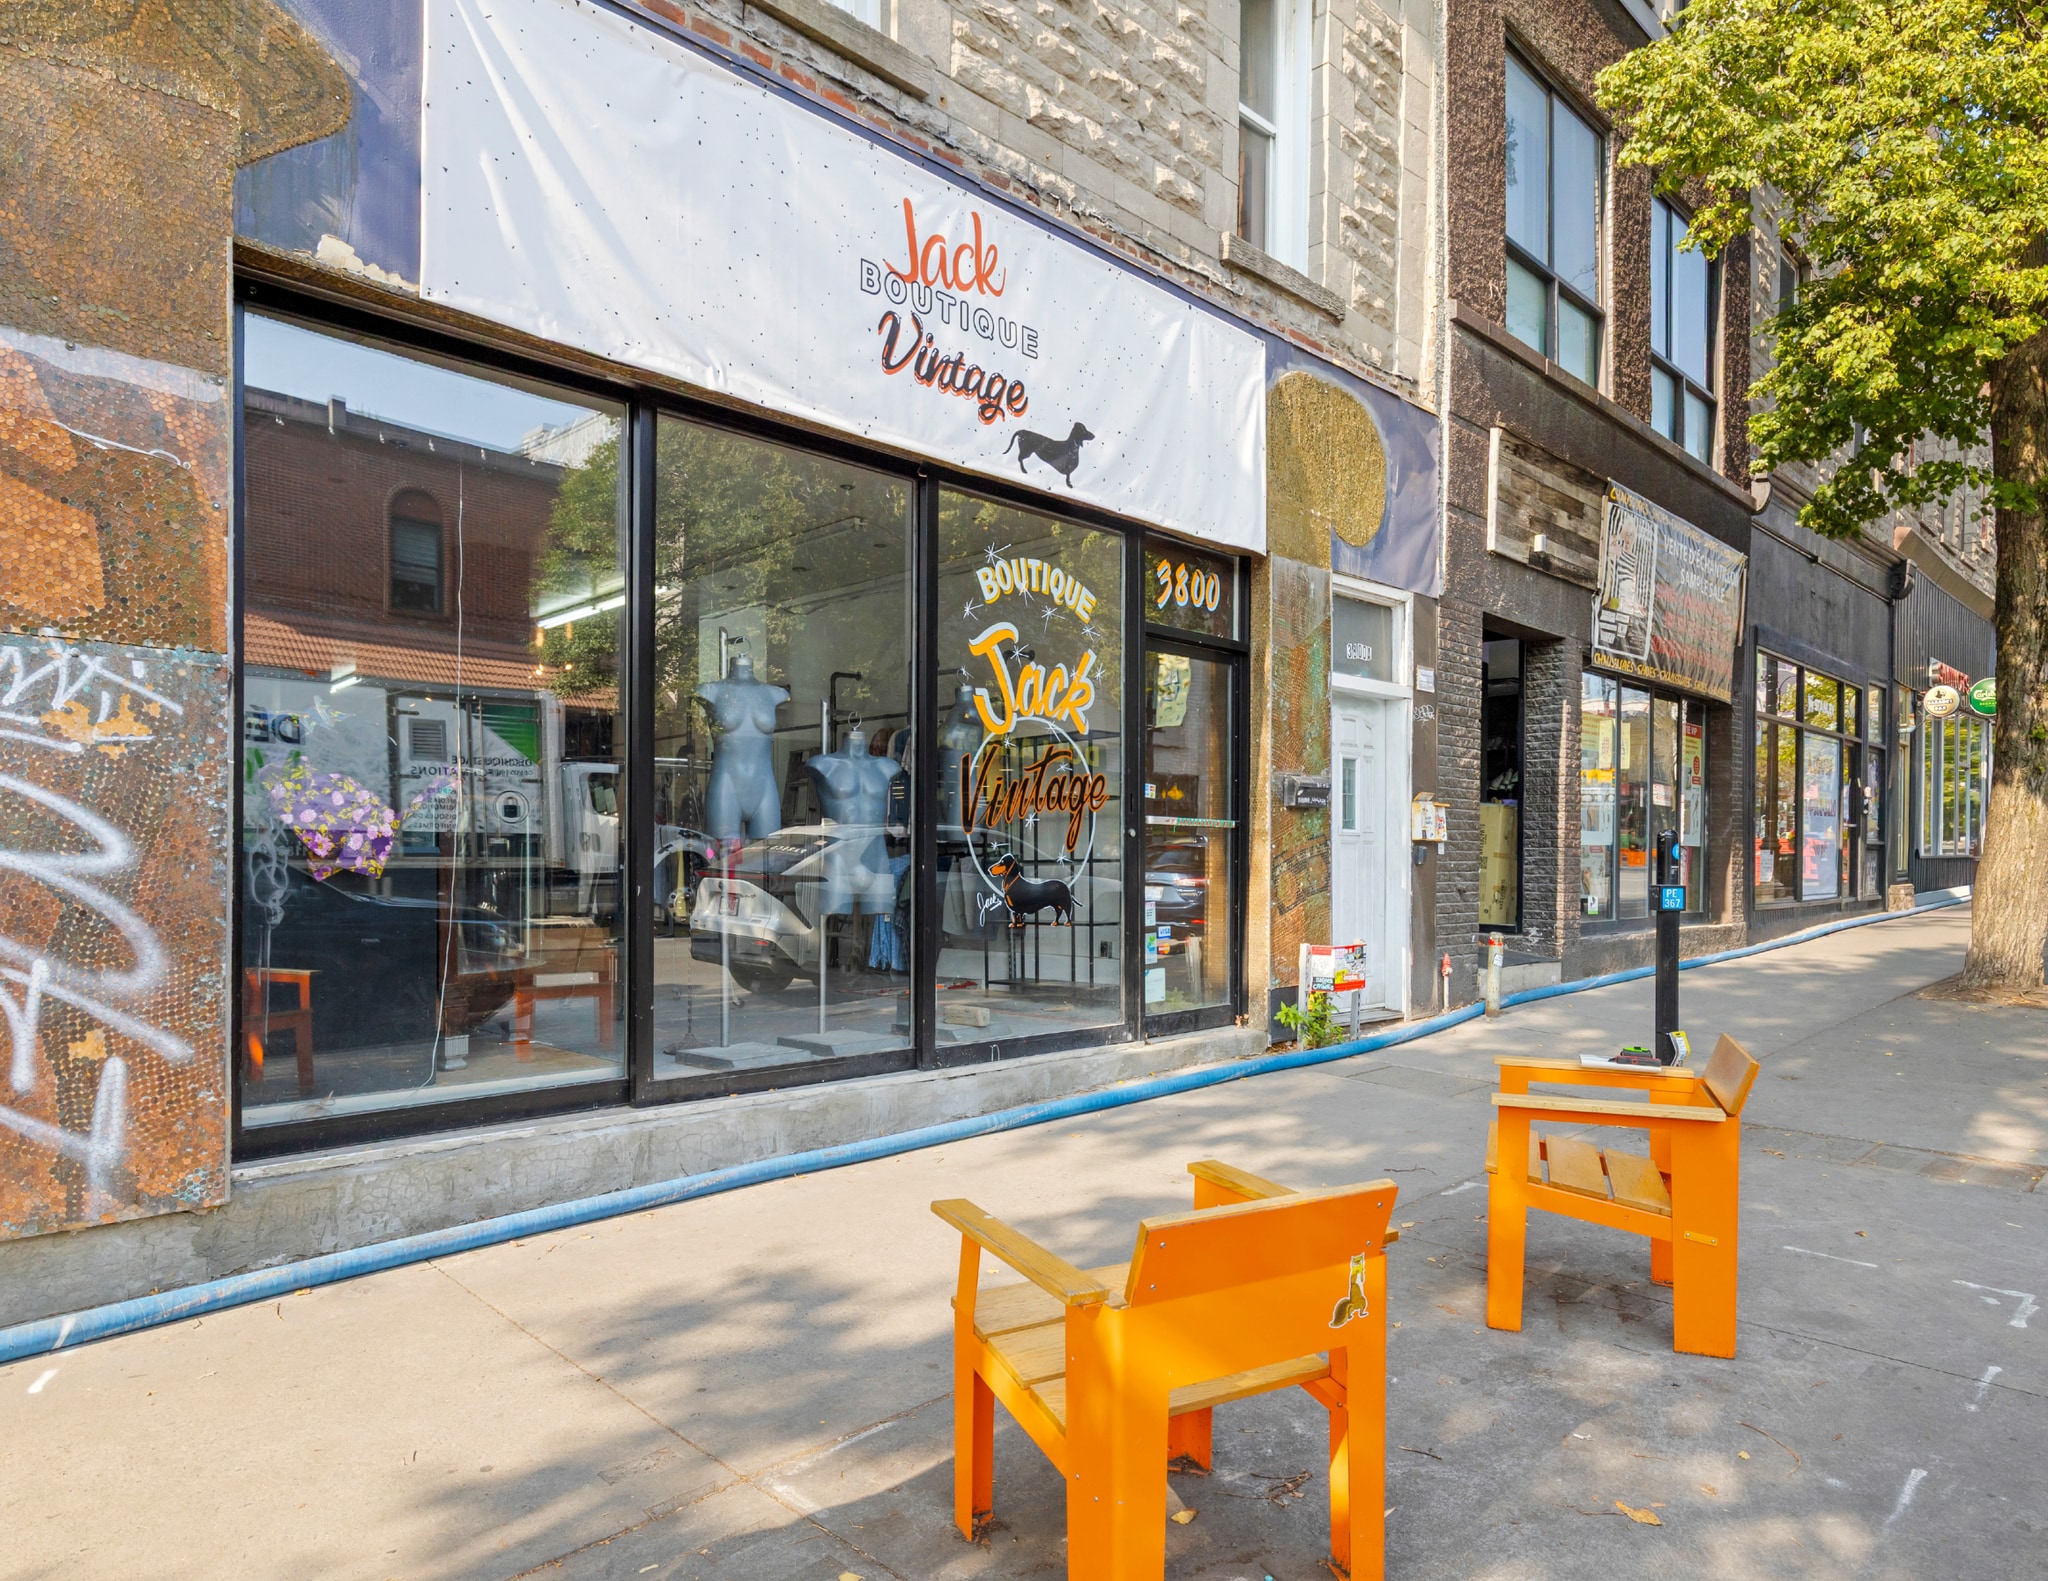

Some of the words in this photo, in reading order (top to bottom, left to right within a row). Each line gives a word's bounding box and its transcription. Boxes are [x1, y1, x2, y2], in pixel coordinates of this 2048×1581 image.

[883, 197, 1006, 297] Jack
[860, 258, 1039, 359] BOUTIQUE
[877, 310, 1029, 425] Vintage
[976, 557, 1097, 624] BOUTIQUE
[1155, 558, 1221, 613] 3800
[968, 621, 1097, 735] Jack
[960, 743, 1110, 852] Vintage
[1664, 899, 1680, 908] 367
[1666, 889, 1677, 898] PE
